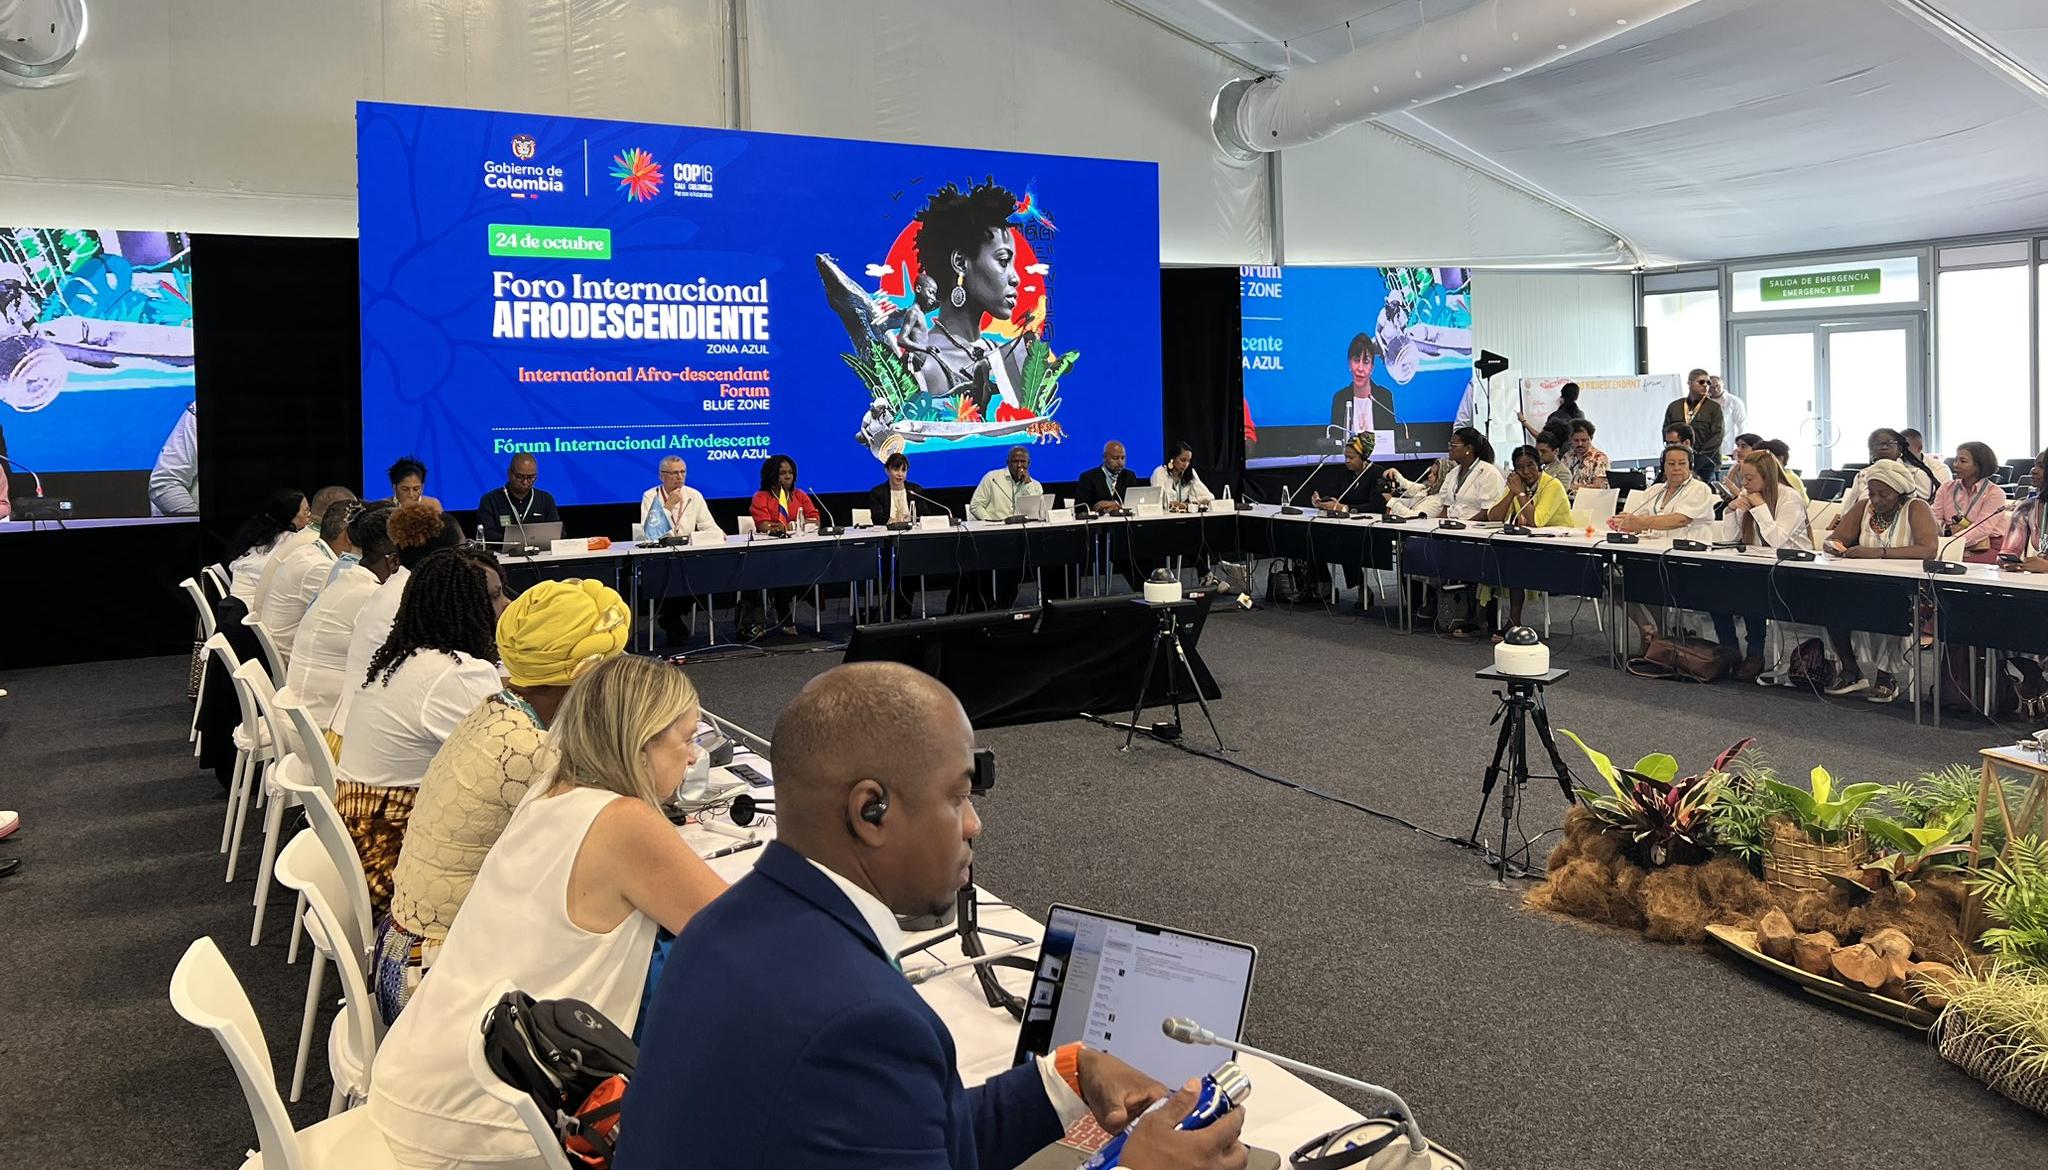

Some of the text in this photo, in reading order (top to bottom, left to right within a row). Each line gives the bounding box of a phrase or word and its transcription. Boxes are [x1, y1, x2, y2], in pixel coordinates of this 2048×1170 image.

[484, 161, 563, 177] Gobierno de
[674, 163, 713, 182] COP16
[485, 174, 563, 192] Colombia
[496, 233, 604, 251] 24 de octubre
[493, 271, 768, 302] Foro Internacional
[1768, 272, 1871, 288] SALIDA DE EMERGENCIA
[1248, 282, 1282, 298] ZONE
[1781, 284, 1856, 297] EMERGENCY EXIT
[493, 300, 769, 340] AFRODESCENDIENTE
[707, 344, 769, 354] ZONA AZUL
[1242, 336, 1282, 351] cente
[1242, 356, 1283, 369] A AZUL
[519, 367, 769, 382] International Afro-descendant
[720, 384, 769, 397] Forum
[703, 399, 769, 410] BLUE ZONE
[494, 434, 770, 453] Fórum Internacional Afrodescente
[707, 449, 771, 460] ZONA AZUL
